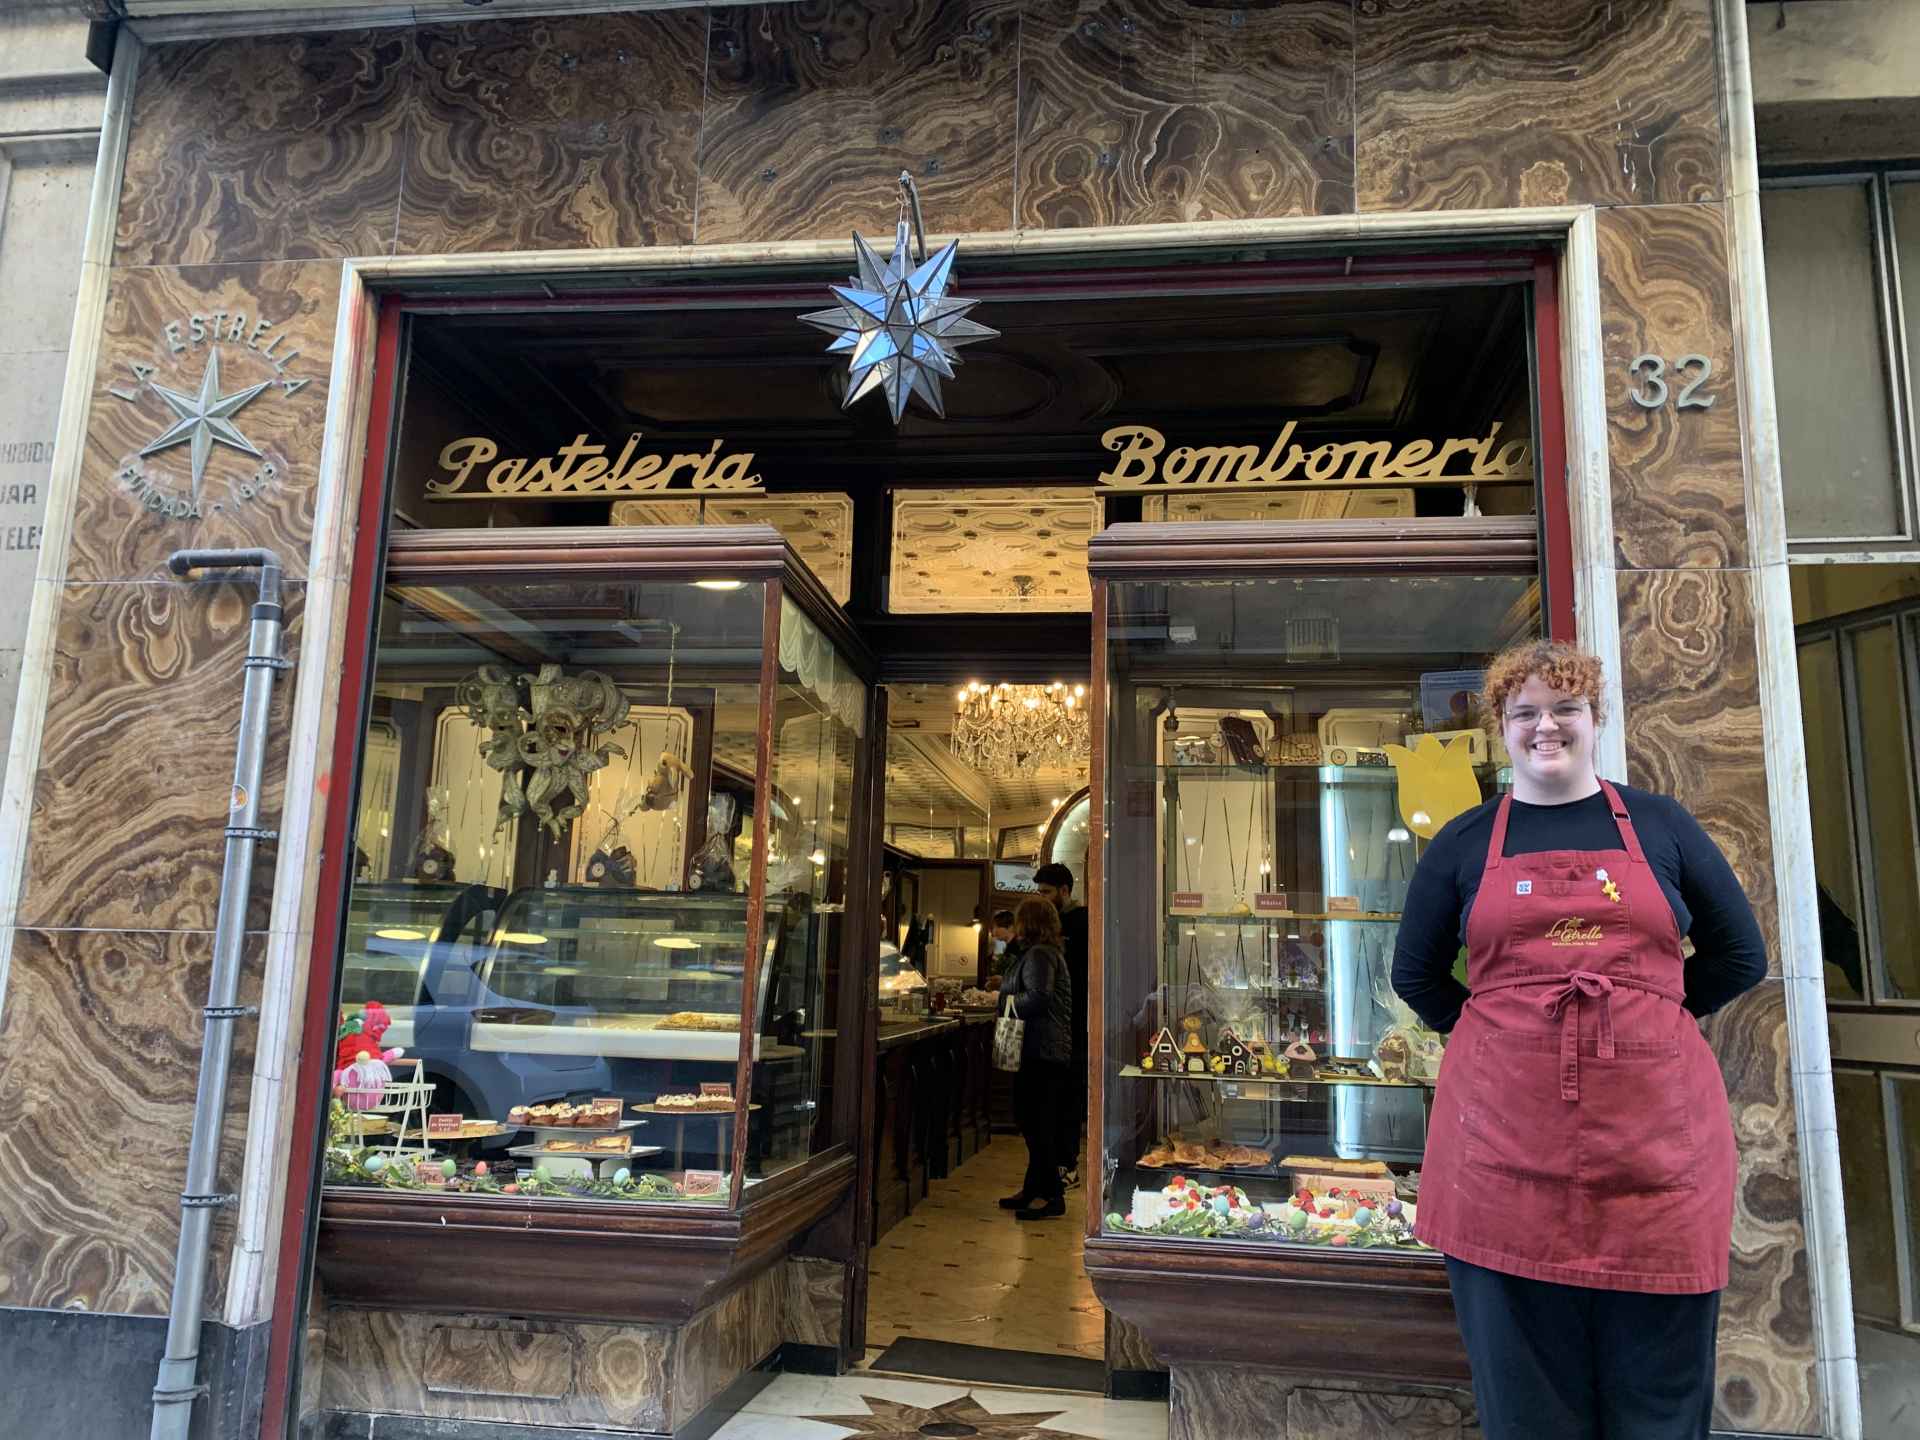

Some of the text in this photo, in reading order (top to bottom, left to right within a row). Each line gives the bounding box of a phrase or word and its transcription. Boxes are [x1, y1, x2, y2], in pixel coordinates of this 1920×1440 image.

[109, 311, 312, 403] LA ESTRELLA
[1630, 353, 1716, 409] 32
[425, 432, 763, 493] Pastelería
